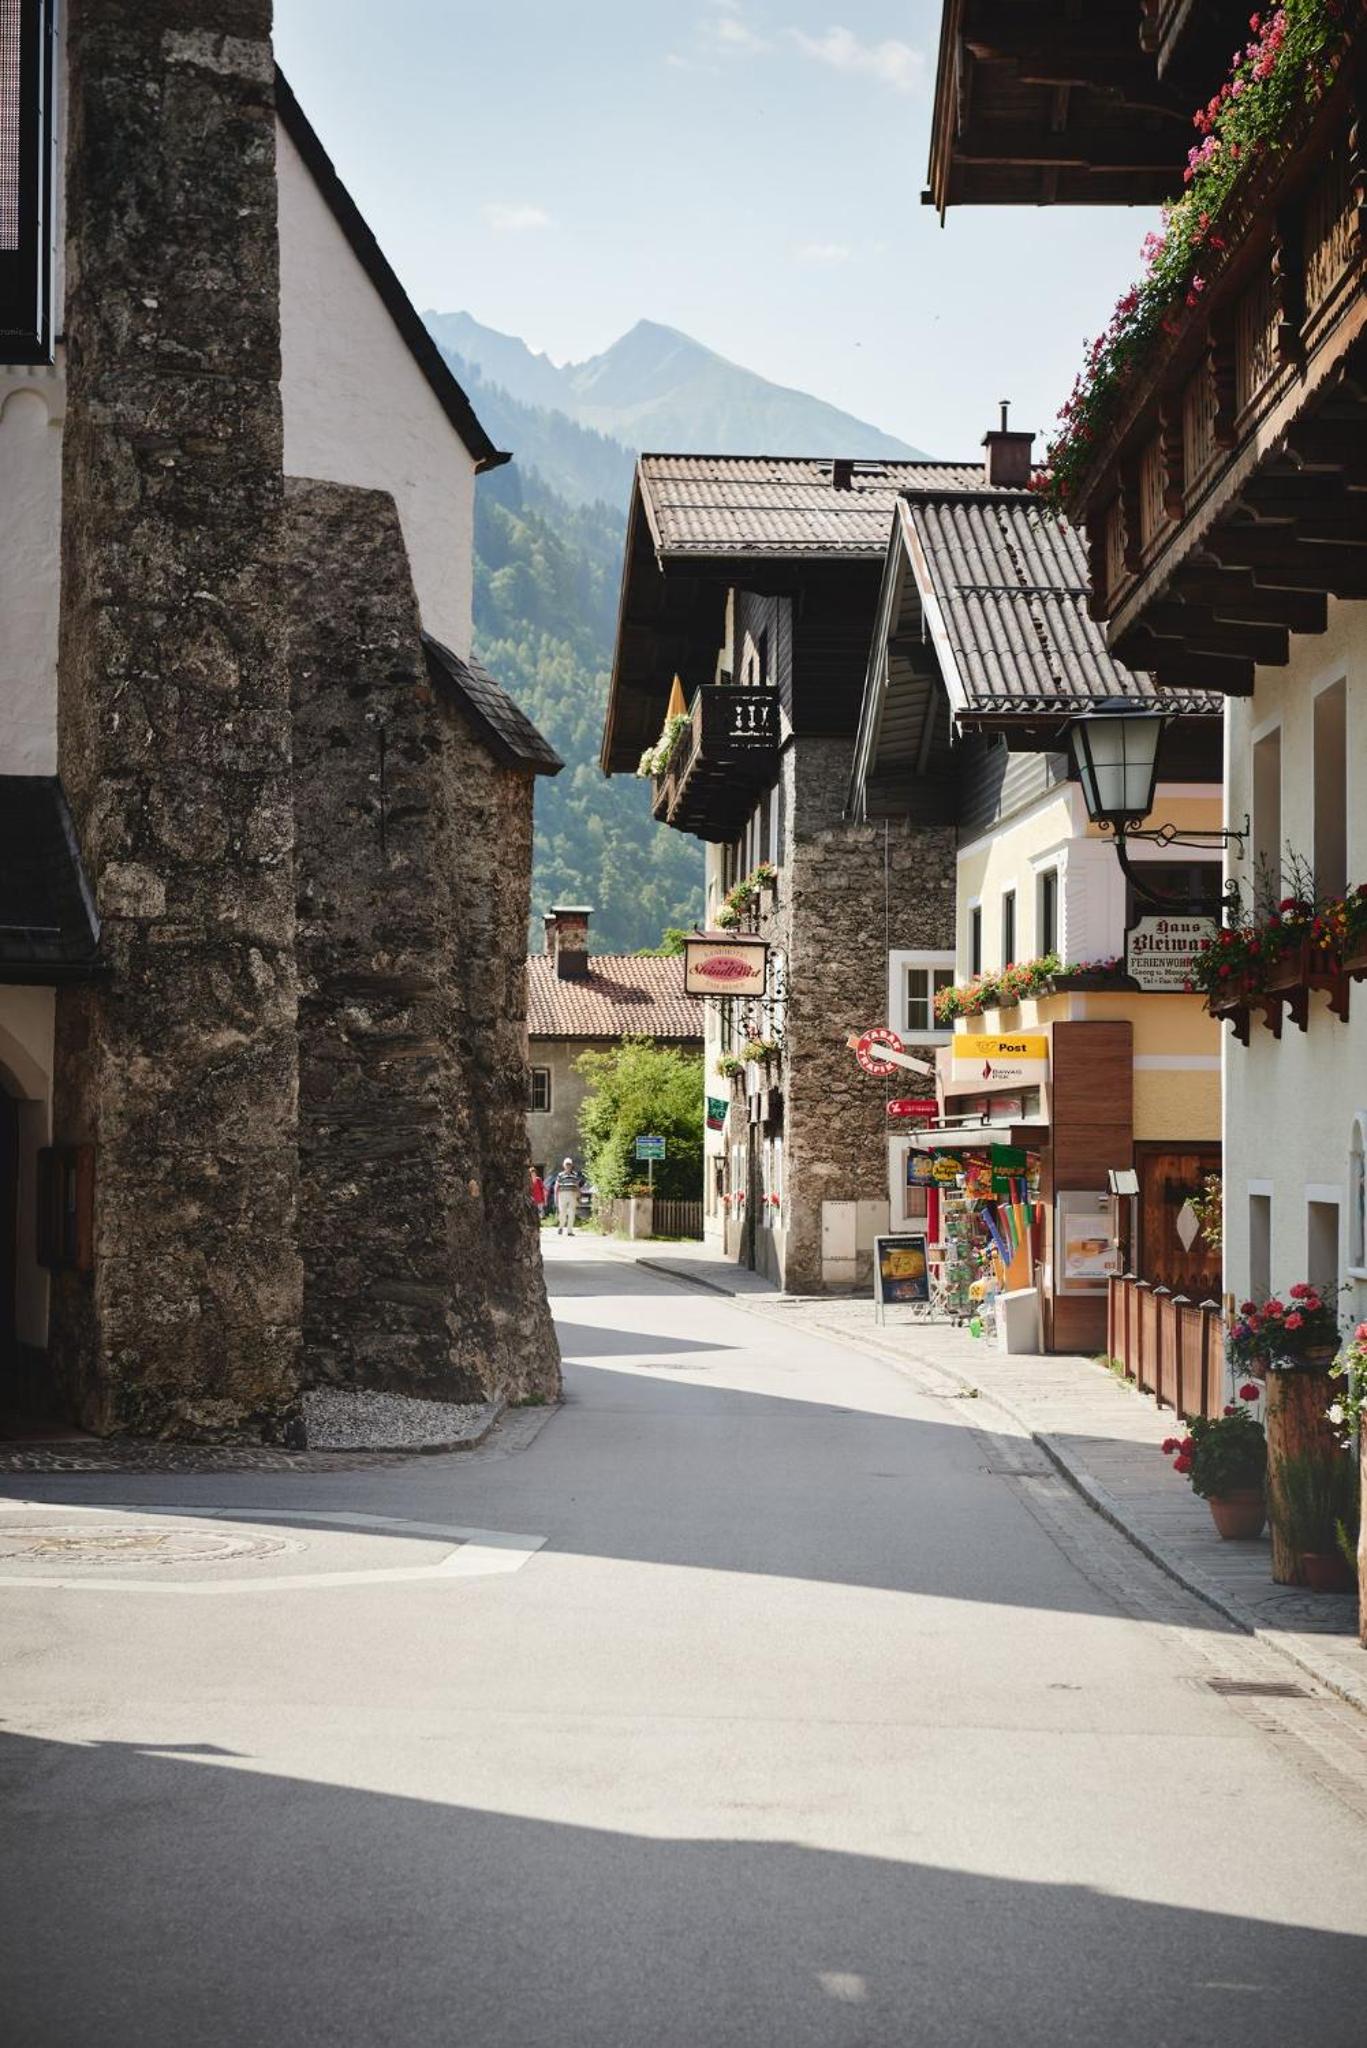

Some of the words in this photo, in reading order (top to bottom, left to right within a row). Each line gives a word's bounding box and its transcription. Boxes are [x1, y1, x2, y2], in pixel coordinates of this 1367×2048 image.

[1156, 919, 1201, 934] Haus
[863, 1030, 901, 1051] TABAK
[998, 1042, 1028, 1052] Post
[858, 1049, 896, 1073] TRAFIK
